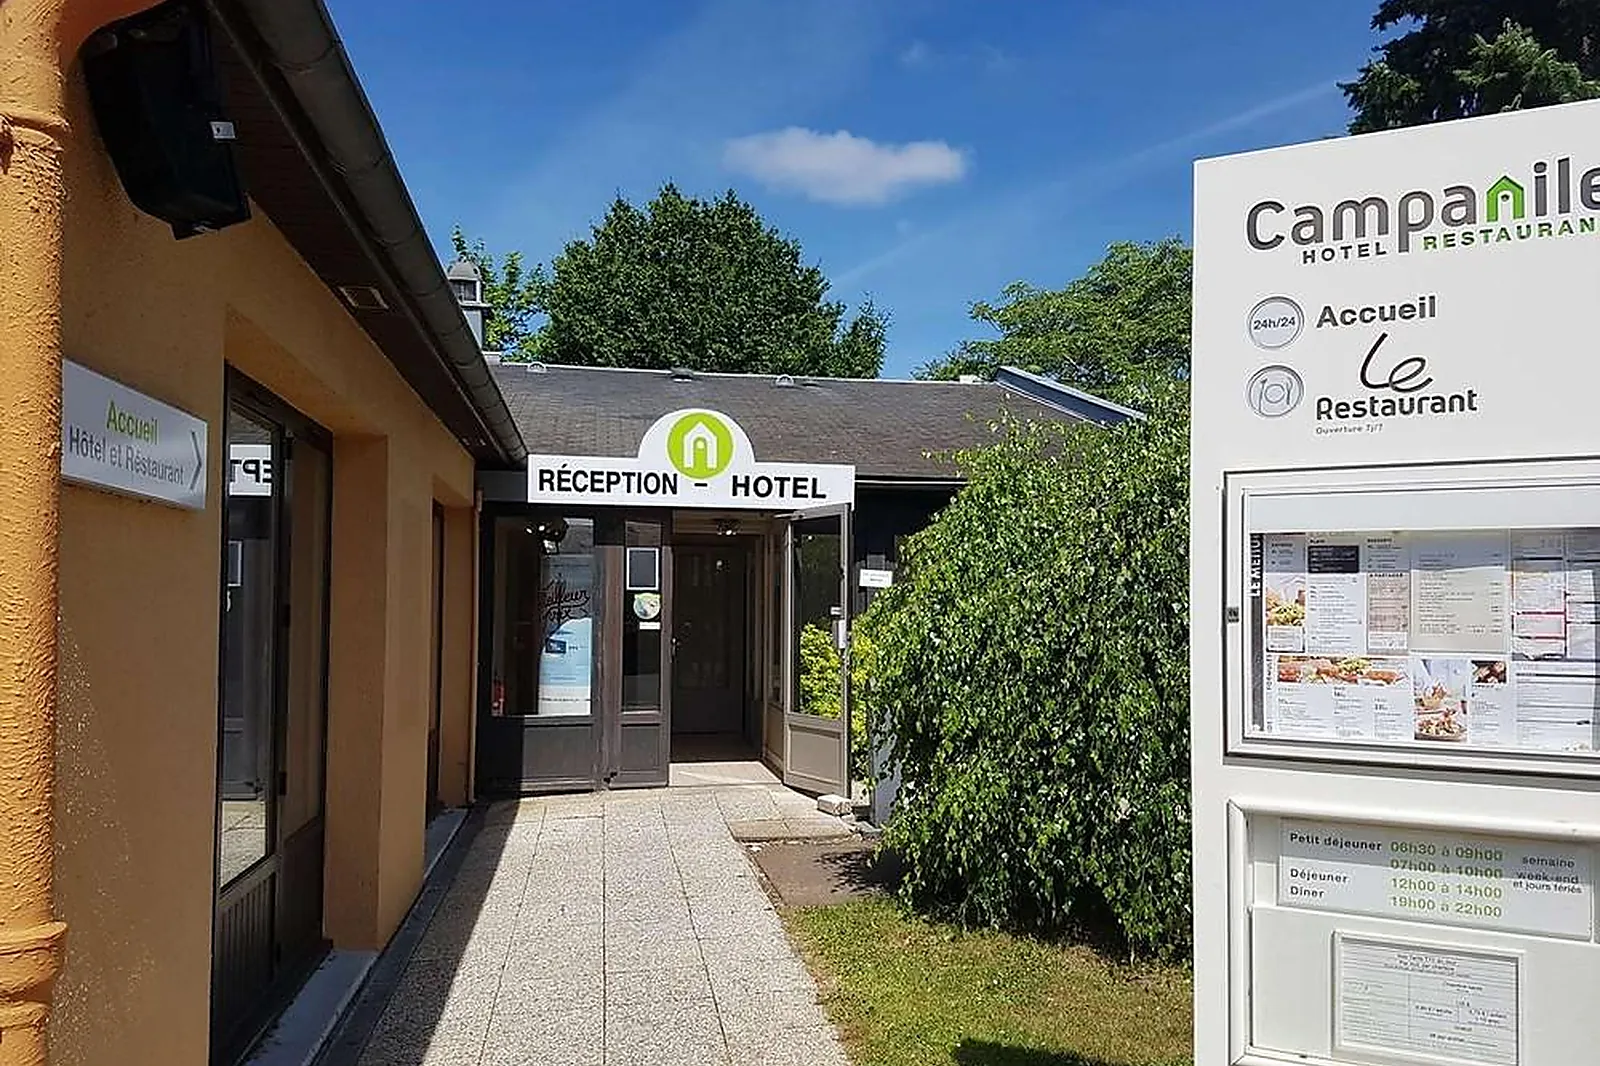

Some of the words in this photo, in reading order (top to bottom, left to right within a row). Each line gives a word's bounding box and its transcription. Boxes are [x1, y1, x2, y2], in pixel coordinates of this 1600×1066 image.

[1247, 157, 1600, 253] Campanile
[1302, 241, 1387, 264] HOTEL
[1423, 217, 1597, 250] RESTAURAN
[1254, 316, 1296, 331] 24h/24
[1316, 296, 1436, 328] Accueil
[1360, 332, 1433, 392] Le
[1316, 389, 1478, 420] Restaurant
[106, 400, 158, 445] Accueil
[69, 425, 106, 463] Hôtel
[110, 441, 122, 467] et
[538, 463, 678, 495] RÉCEPTION
[731, 475, 827, 499] HOTEL
[1290, 833, 1320, 845] Petit
[1324, 836, 1382, 851] déjeuner
[1390, 841, 1436, 856] 06h30
[1455, 847, 1503, 861] 09h00
[1522, 857, 1575, 868] semaine
[1290, 868, 1348, 884] Déjeuner
[1391, 878, 1436, 892] 12h00
[1456, 884, 1502, 898] 14h00
[1390, 859, 1436, 873] 07h00
[1456, 865, 1503, 879] 10h00
[1525, 881, 1551, 891] jours
[1391, 896, 1436, 910] 19h00
[1456, 902, 1502, 918] 22h00
